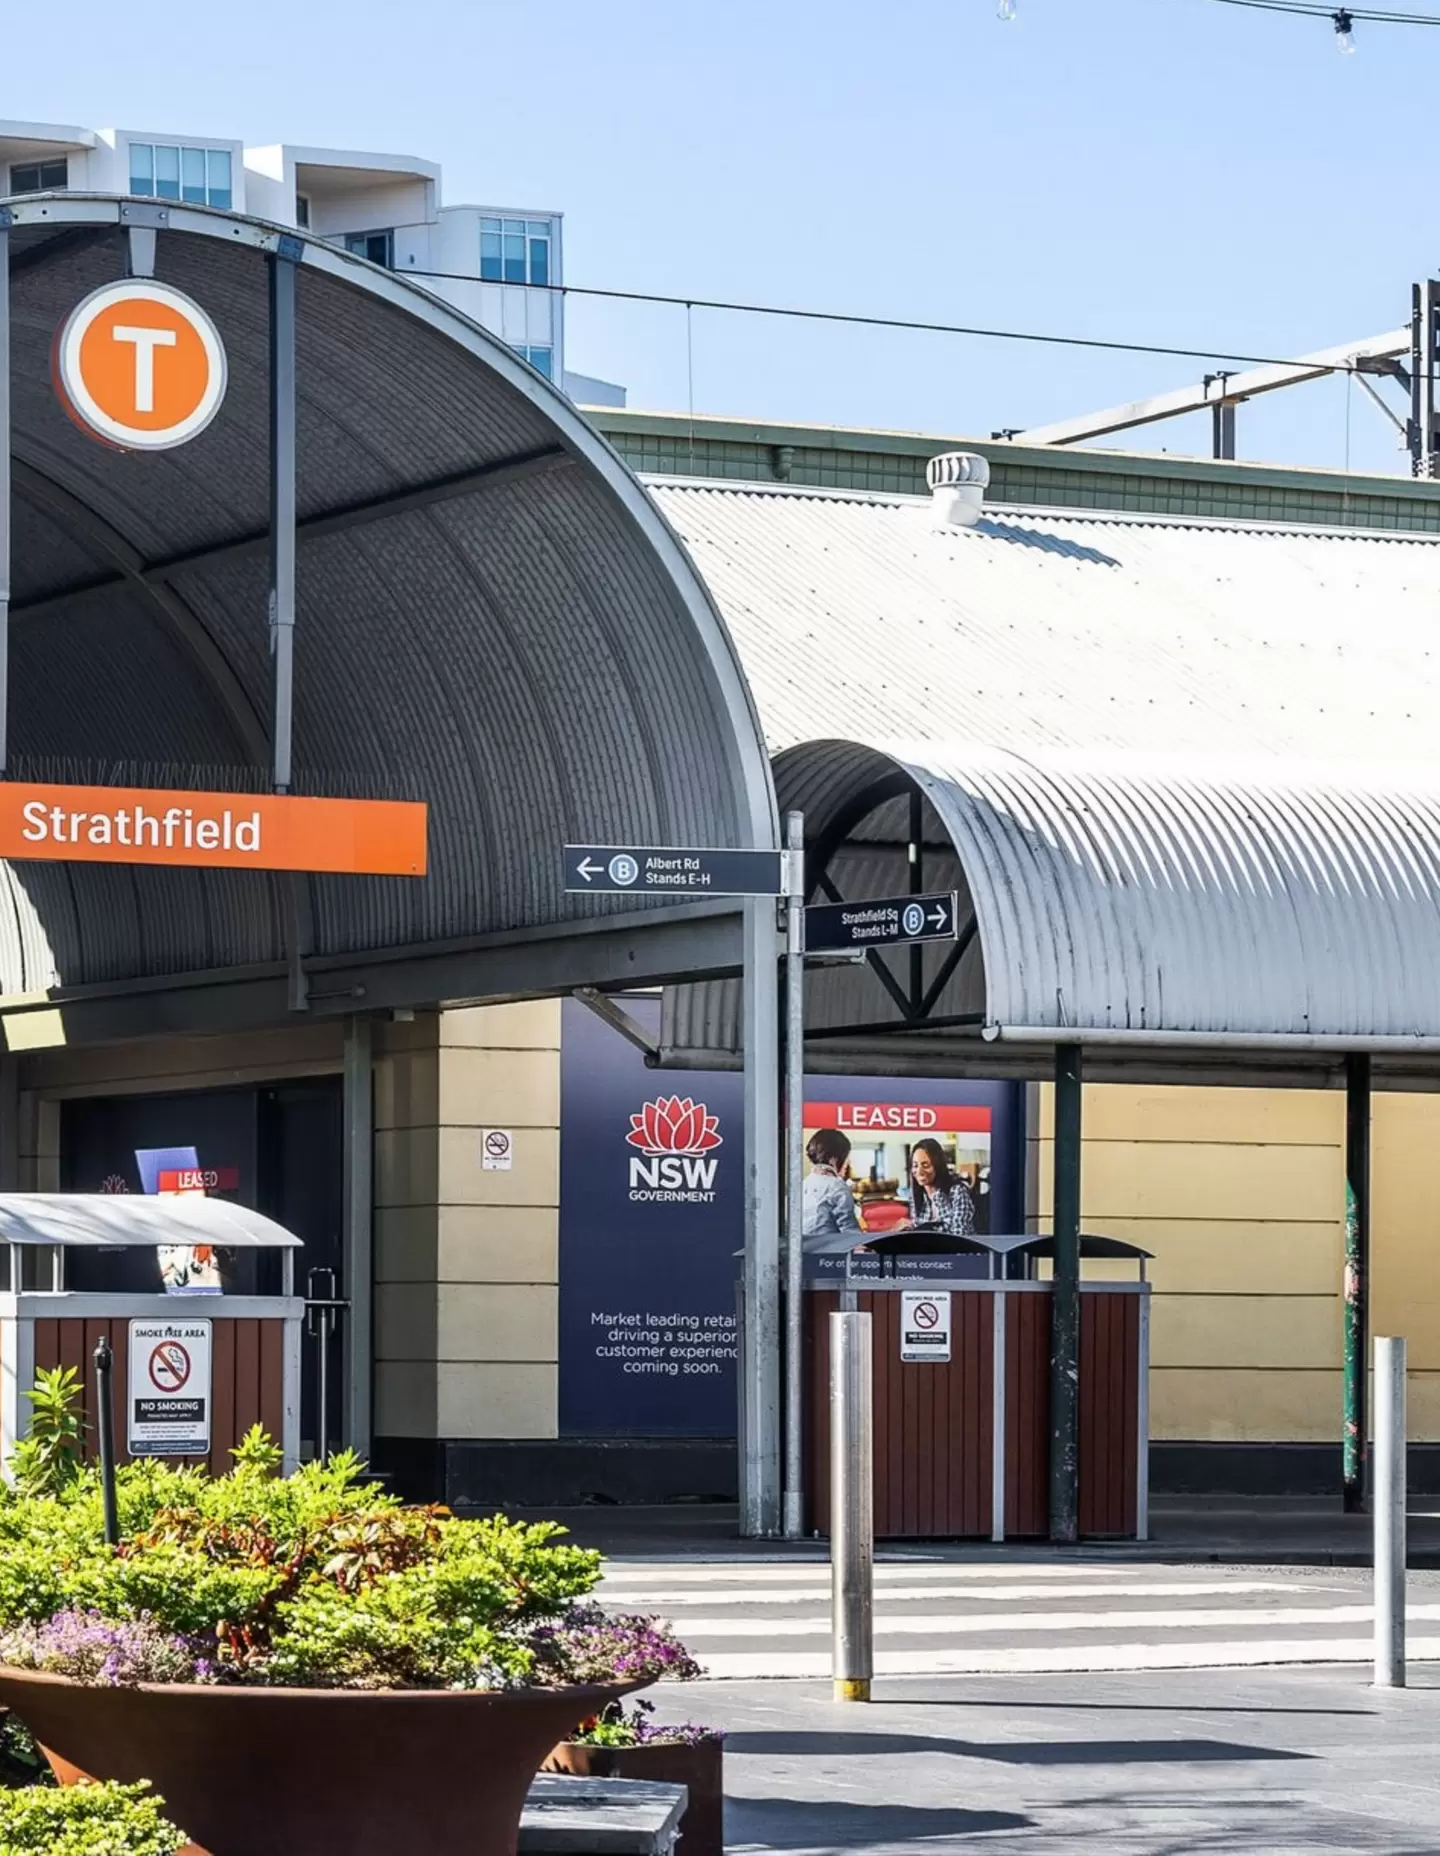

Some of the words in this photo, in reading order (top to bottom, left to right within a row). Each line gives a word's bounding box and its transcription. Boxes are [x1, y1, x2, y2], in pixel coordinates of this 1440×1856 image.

[113, 324, 177, 413] T
[21, 800, 261, 852] Strathfield
[618, 861, 630, 879] B
[645, 857, 682, 870] Albert
[683, 858, 700, 870] Rd
[645, 872, 687, 885] Stands
[688, 873, 711, 885] E-H
[841, 908, 886, 925] Strathfield
[887, 907, 899, 921] Sq
[851, 925, 880, 939] Stands
[881, 923, 899, 936] L-M
[836, 1105, 937, 1128] LEASED
[177, 1170, 218, 1189] LEASED
[629, 1157, 719, 1190] NSW
[628, 1190, 716, 1203] GOVERNMENT
[818, 1258, 834, 1268] For
[590, 1312, 642, 1326] Market
[645, 1312, 700, 1329] leading
[703, 1313, 737, 1327] retai
[135, 1329, 163, 1338] SMOKE
[164, 1328, 182, 1338] FREE
[184, 1329, 206, 1338] AREA
[607, 1328, 660, 1344] driving
[663, 1332, 673, 1342] a
[676, 1330, 738, 1344] superior
[595, 1344, 665, 1358] customer
[669, 1345, 739, 1360] experienc
[622, 1359, 679, 1375] coming
[682, 1361, 722, 1374] soon.
[140, 1401, 156, 1411] NO
[157, 1401, 199, 1411] SMOKING
